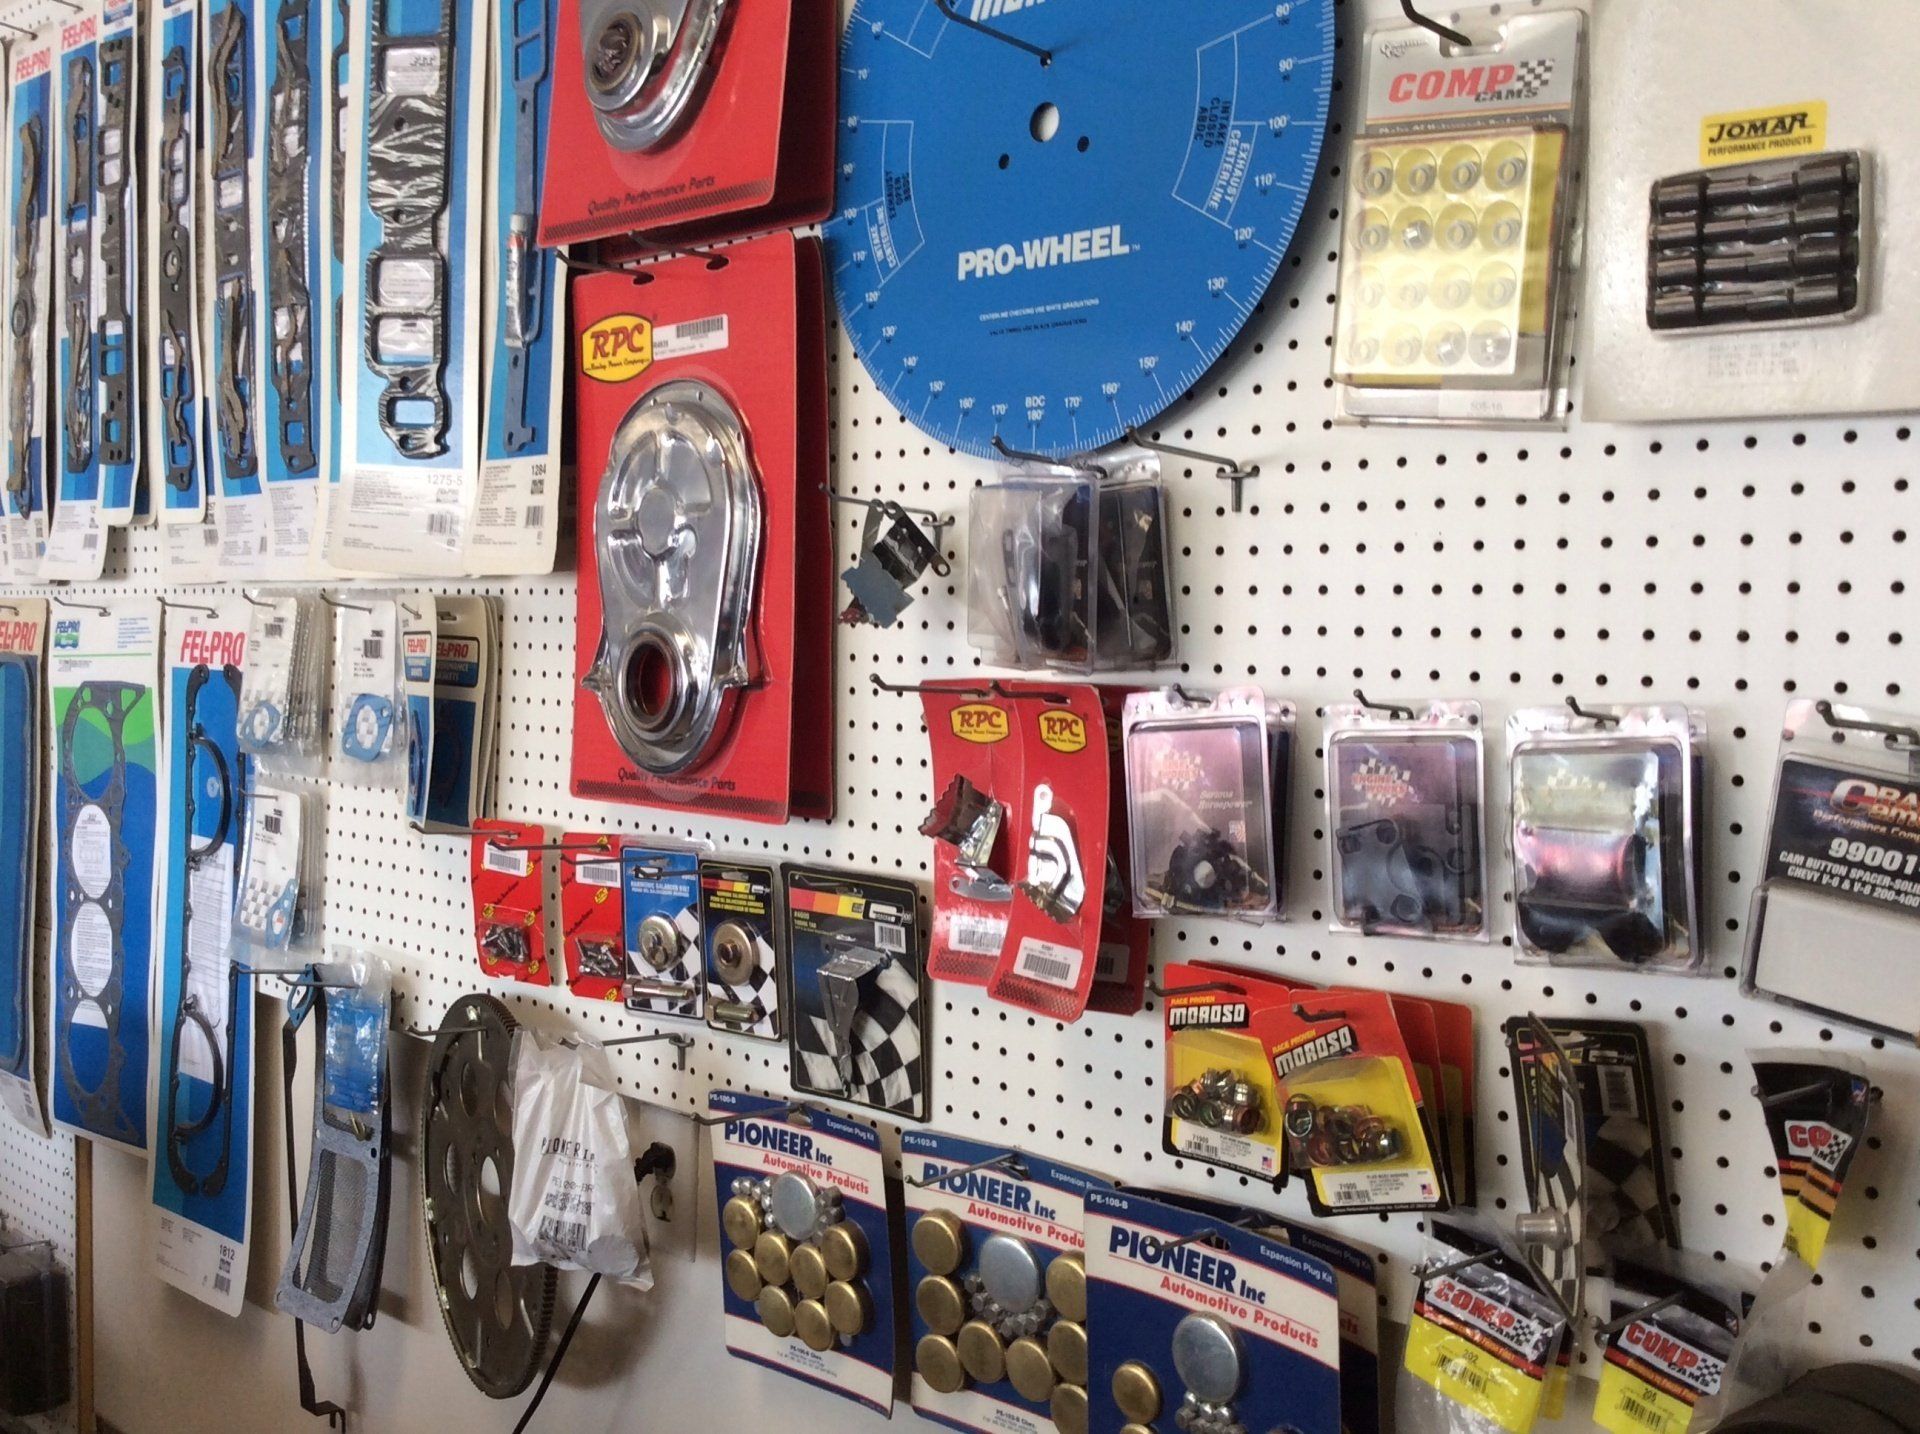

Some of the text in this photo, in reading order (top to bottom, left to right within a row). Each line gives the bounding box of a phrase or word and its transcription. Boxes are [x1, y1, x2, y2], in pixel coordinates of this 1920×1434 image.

[1388, 64, 1515, 104] COMP
[1475, 86, 1540, 103] CAMS
[1709, 112, 1808, 143] JOMAR
[1707, 134, 1812, 157] PERFORMANCE PRODUCTS
[1209, 129, 1241, 211] CENTERLINE
[1224, 142, 1250, 204] EXHAUST
[624, 181, 686, 204] Performance
[688, 175, 715, 190] Parts
[957, 225, 1129, 281] PRO-WHEEL
[590, 322, 645, 360] RPC
[1025, 396, 1045, 408] BDC
[531, 464, 547, 477] 1284
[958, 711, 1002, 728] RPC
[1044, 717, 1081, 737] RPC
[711, 777, 736, 791] Parts
[1779, 851, 1804, 867] CAM
[1805, 857, 1848, 877] BUTTON
[1787, 865, 1818, 882] CHEVY
[1821, 874, 1840, 888] V-6
[1842, 880, 1851, 892] &
[1190, 995, 1215, 1003] PROVEN
[1169, 1003, 1245, 1026] MOROSO
[1275, 1026, 1353, 1077] MOROSO
[1291, 1029, 1316, 1047] PROVEN
[725, 1121, 833, 1166] PIONEER Inc
[826, 1118, 875, 1142] Expansion Plug Kit
[763, 1152, 869, 1195] Automotive Products
[1051, 1169, 1085, 1189] Expansion
[923, 1162, 1057, 1221] PIONEER Inc
[968, 1202, 1086, 1249] Automotive Produ
[218, 1243, 235, 1260] 1812
[1109, 1225, 1266, 1305] PIONEER Inc
[1260, 1245, 1333, 1285] Expansion Plug Kit
[1160, 1275, 1248, 1319] Automotive
[1253, 1309, 1318, 1349] Products
[1434, 1280, 1515, 1328] COMP
[1626, 1321, 1700, 1368] COMP
[1668, 1361, 1711, 1388] CAMS
